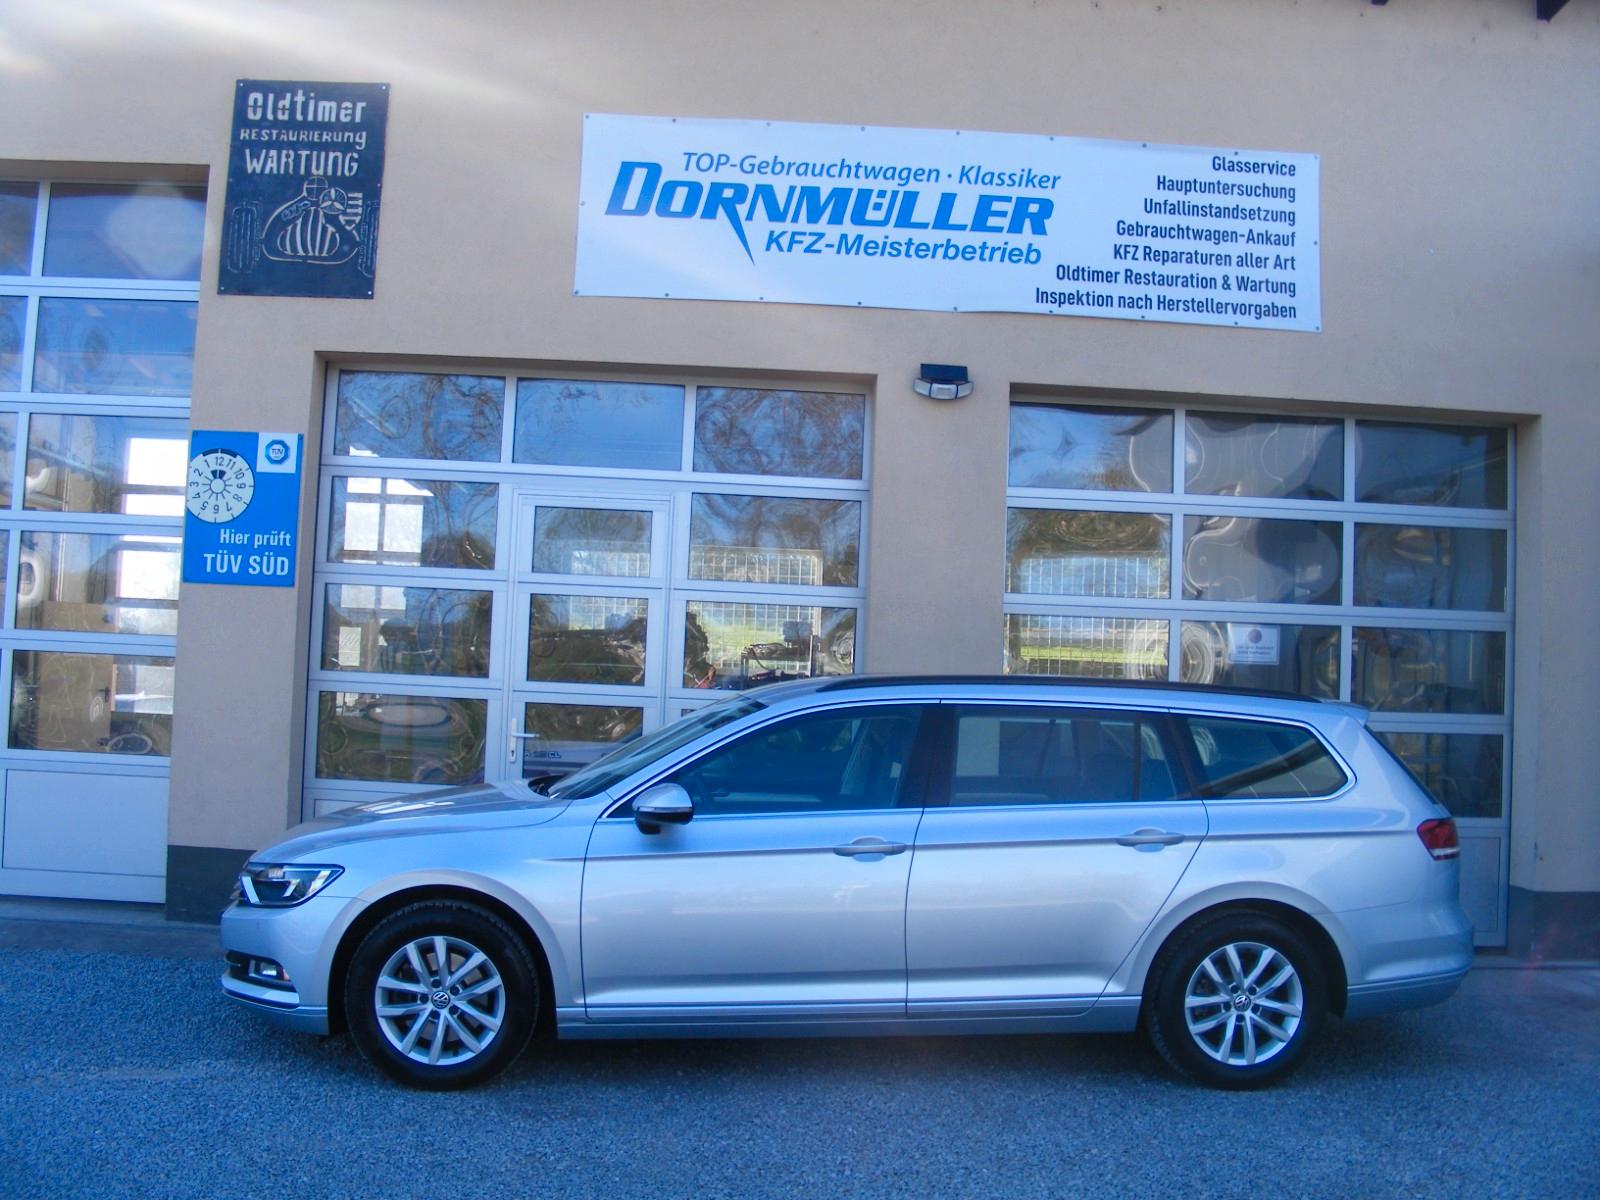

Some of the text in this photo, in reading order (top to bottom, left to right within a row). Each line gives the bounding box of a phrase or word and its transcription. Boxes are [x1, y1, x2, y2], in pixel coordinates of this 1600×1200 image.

[247, 89, 367, 123] Oldtimer
[683, 151, 1062, 190] TOP-Gebrauchtwagen Klassiker
[1212, 155, 1296, 177] Glasservice
[1157, 175, 1296, 203] Hauptuntersuchung
[1144, 198, 1296, 226] Unfallinstandsetzung
[1116, 220, 1296, 247] Gebrauchtwagen-Ankauf
[764, 230, 1042, 266] KFZ-Meisterbetrieb
[1113, 243, 1296, 271] KFZ Reparaturen aller Art
[1056, 264, 1296, 298] Oldtimer Restauration & Wartung
[1035, 288, 1296, 320] Inspektion nach Herstellervorgaben
[215, 456, 225, 466] 12
[233, 468, 245, 480] 10
[220, 528, 291, 549] Hier prüft
[203, 550, 289, 576] TÜV SÜD
